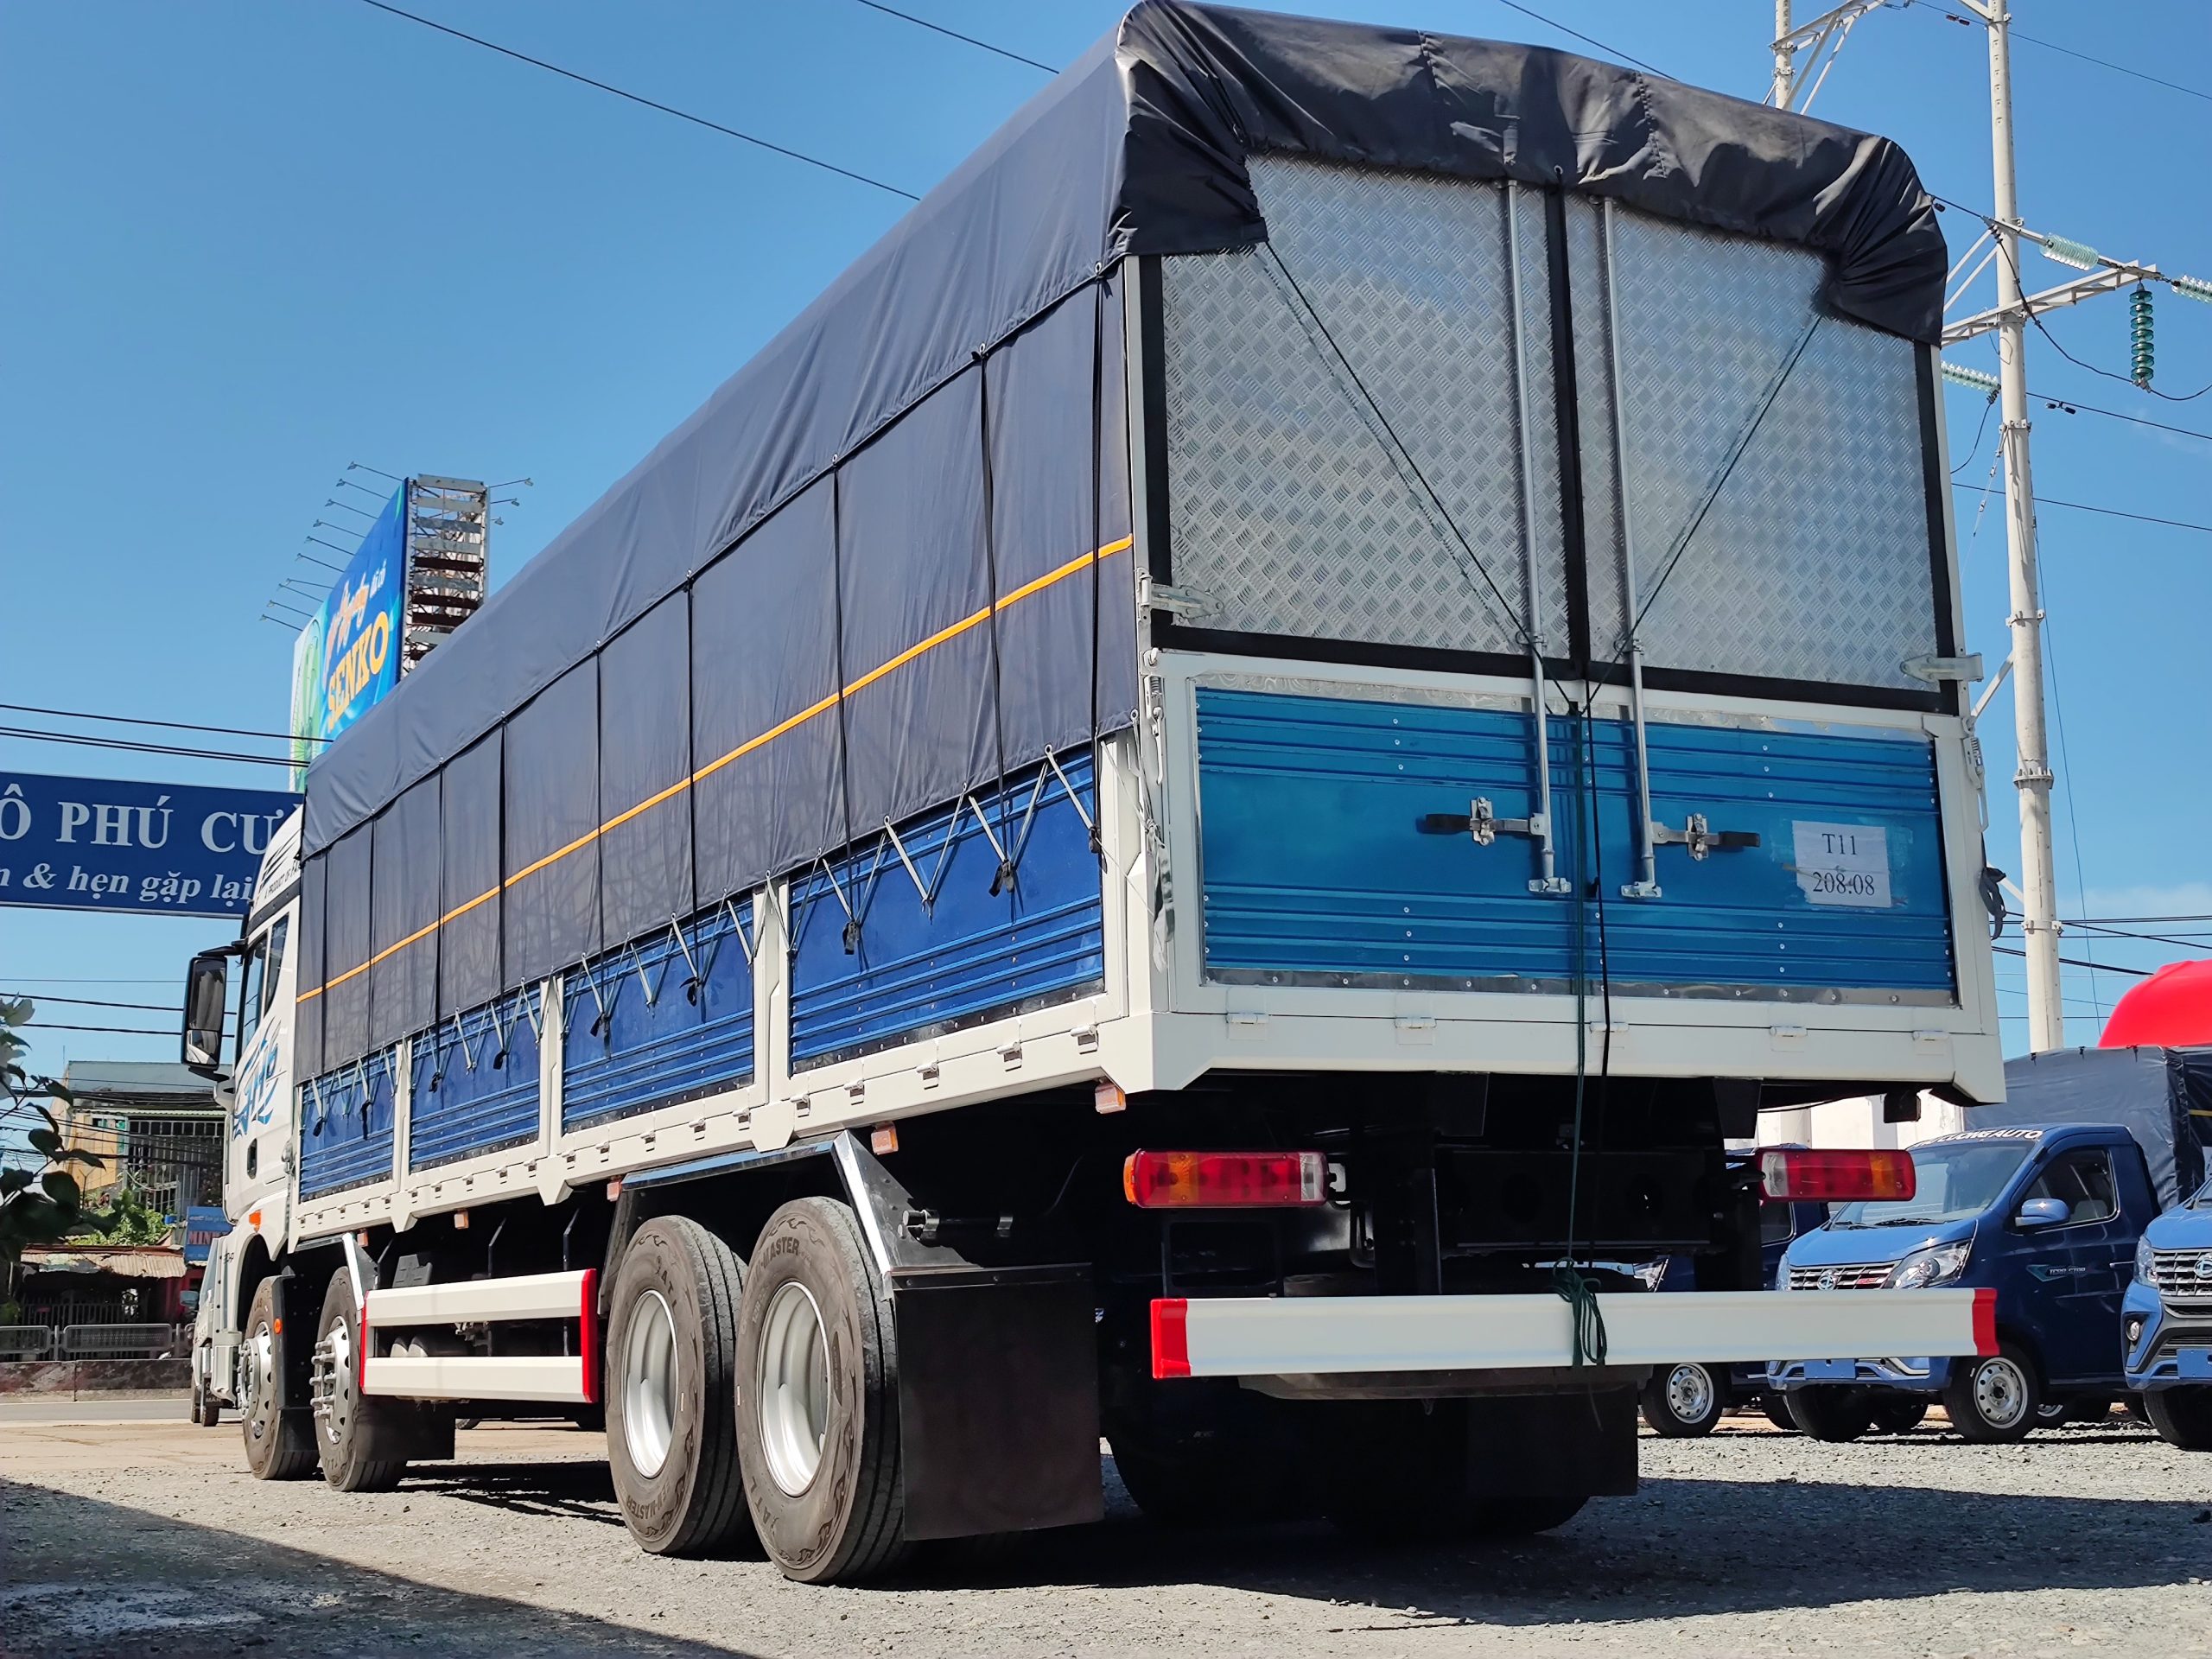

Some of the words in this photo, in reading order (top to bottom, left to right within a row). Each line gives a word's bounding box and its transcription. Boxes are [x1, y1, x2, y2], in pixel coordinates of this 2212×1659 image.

[327, 610, 389, 734] SENKO
[55, 795, 174, 849] PHÚ
[200, 808, 285, 855] CƯ
[1821, 833, 1857, 855] T11
[22, 863, 58, 889] &
[67, 866, 129, 899] hẹn
[139, 871, 201, 904] gặp
[209, 874, 252, 906] lại
[1812, 871, 1875, 896] 208.08
[1989, 1129, 2044, 1139] AUTO
